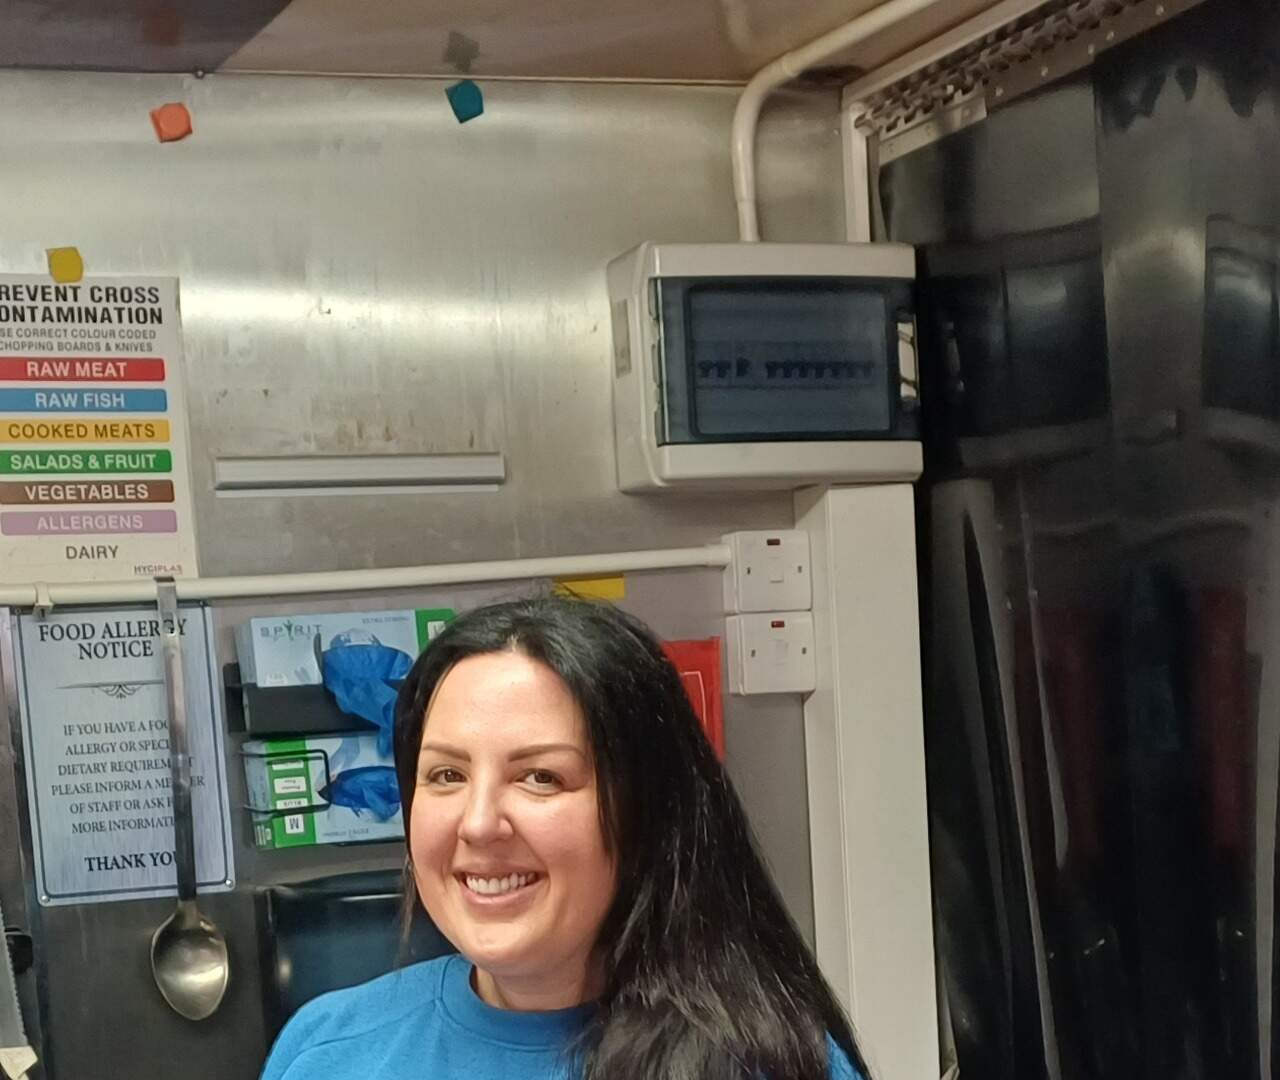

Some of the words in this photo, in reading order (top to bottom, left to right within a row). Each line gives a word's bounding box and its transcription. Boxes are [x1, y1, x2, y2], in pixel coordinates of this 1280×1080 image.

[90, 286, 160, 304] CROSS
[16, 328, 68, 338] CORRECT
[71, 329, 116, 339] COLOUR
[118, 329, 156, 339] CODED
[57, 342, 102, 351] BOARDS
[106, 342, 112, 351] &
[115, 342, 153, 352] KNIVES
[26, 361, 70, 377] RAW
[75, 362, 127, 377] MEAT
[35, 393, 77, 408] RAW
[84, 393, 125, 408] FISH
[8, 423, 88, 439] COOKED
[95, 423, 156, 438] MEATS
[10, 454, 84, 470] SALADS
[88, 454, 101, 469] &
[104, 454, 156, 469] FRUIT
[25, 484, 149, 500] VEGETABLES
[37, 515, 143, 530] ALLERGENS
[65, 545, 119, 560] DAIRY
[39, 623, 95, 642] FOOD
[78, 640, 154, 660] NOTICE
[64, 724, 73, 737] IF
[76, 722, 102, 736] YOU
[104, 721, 136, 734] HAVE
[138, 721, 147, 733] A
[149, 719, 169, 731] FOO
[65, 741, 118, 757] ALLERGY
[120, 741, 137, 753] OR
[138, 739, 170, 752] SPECI
[58, 761, 108, 777] DIETARY
[110, 756, 194, 773] REQUIREMT
[51, 782, 97, 796] PLEASE
[95, 779, 142, 793] INFORM
[144, 779, 152, 789] A
[155, 775, 205, 789] MEER
[70, 802, 86, 814] OF
[88, 800, 121, 813] STAFF
[123, 799, 141, 811] OR
[143, 798, 165, 809] ASK
[72, 820, 106, 834] MORE
[108, 816, 175, 832] INFORMATI
[84, 853, 146, 872] THANK
